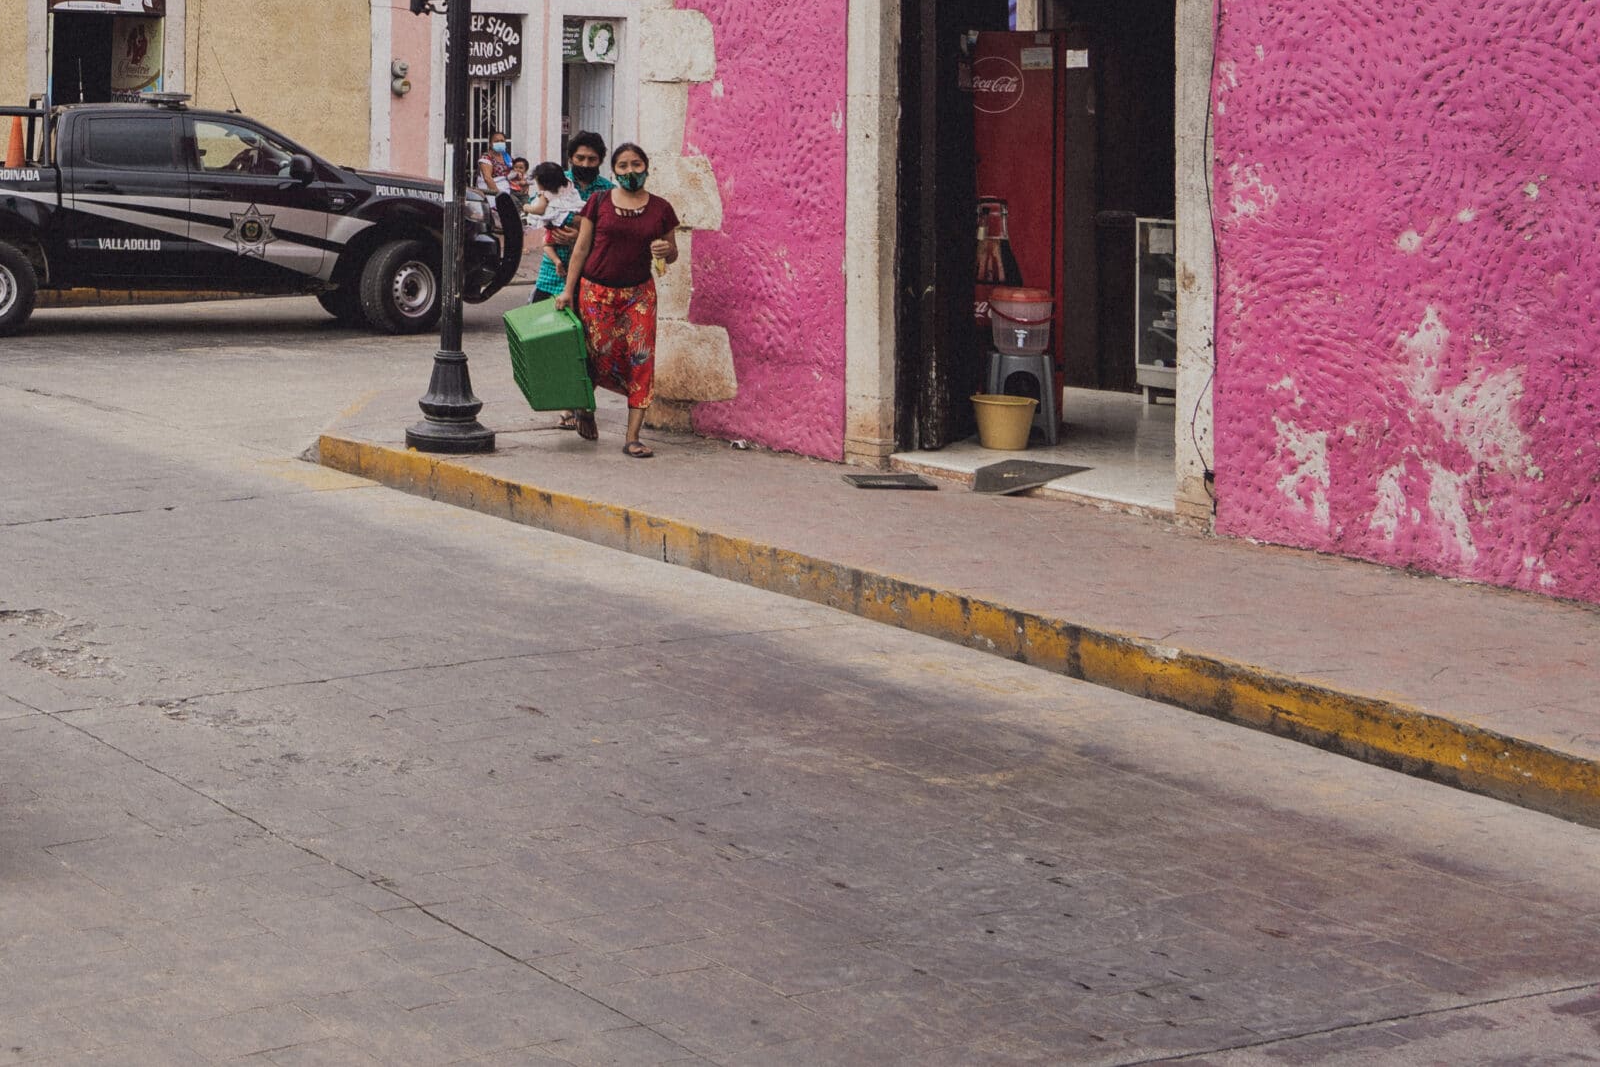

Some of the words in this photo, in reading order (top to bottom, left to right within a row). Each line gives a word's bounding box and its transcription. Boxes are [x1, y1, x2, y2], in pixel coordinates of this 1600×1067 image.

[486, 16, 520, 46] SHOP
[468, 55, 517, 76] UQUERIA
[376, 185, 406, 198] POLICIA
[408, 188, 444, 204] MUNICIPA
[98, 237, 161, 251] VALLADOLID
